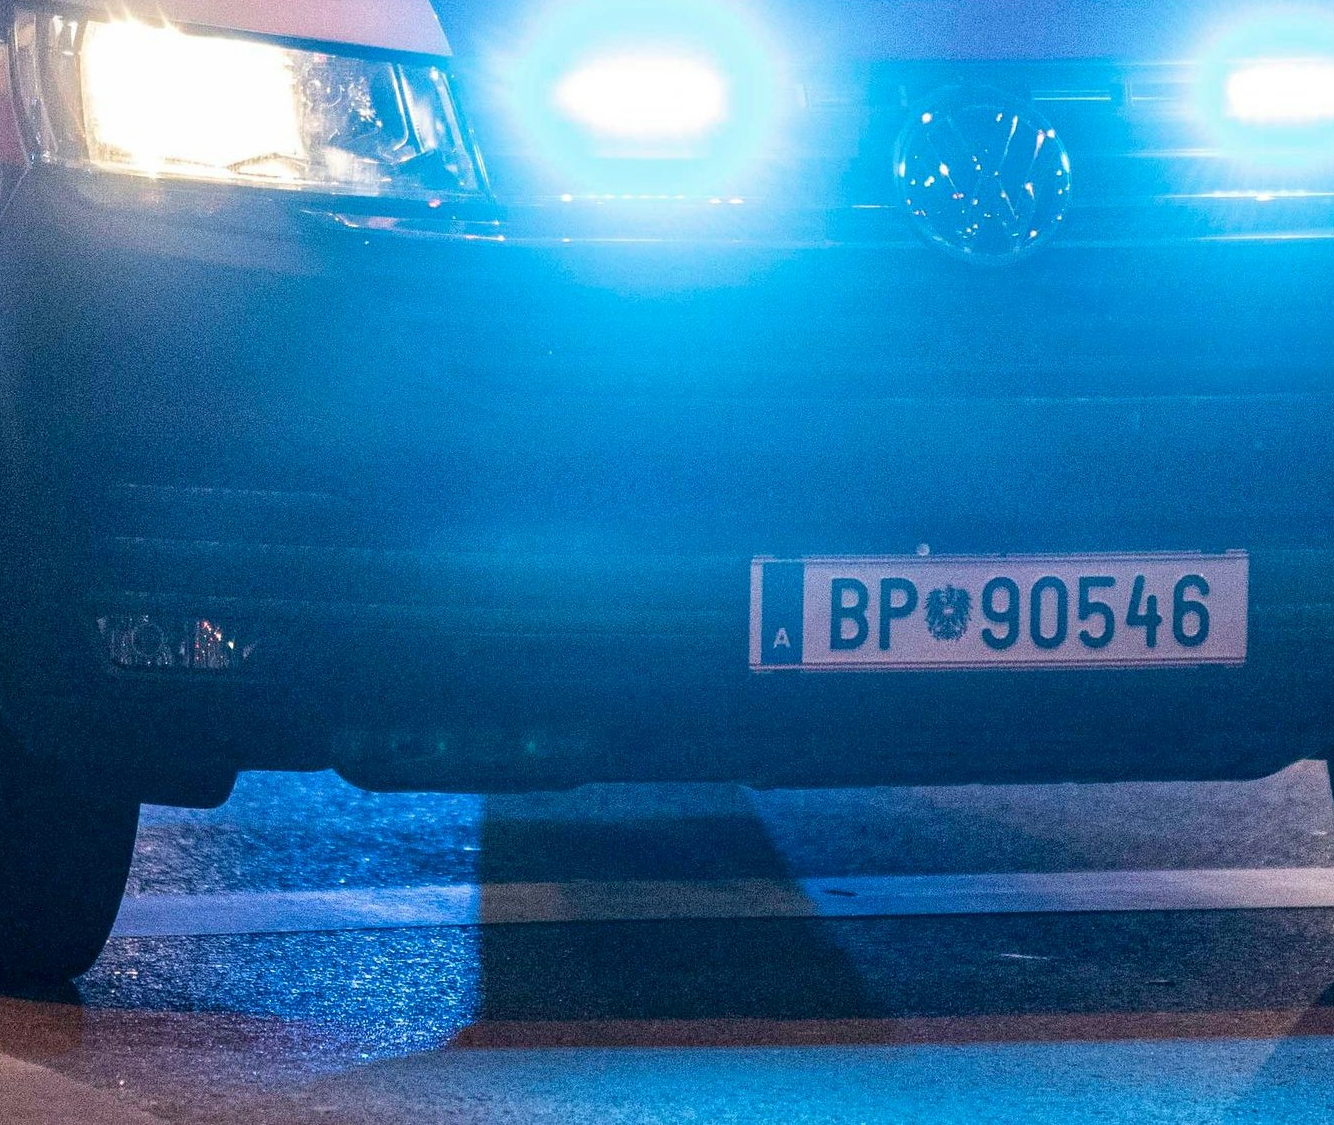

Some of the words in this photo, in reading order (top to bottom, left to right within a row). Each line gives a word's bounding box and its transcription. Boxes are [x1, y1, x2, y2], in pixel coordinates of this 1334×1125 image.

[829, 576, 919, 652] BP
[981, 573, 1211, 651] 90546
[772, 627, 792, 649] A
